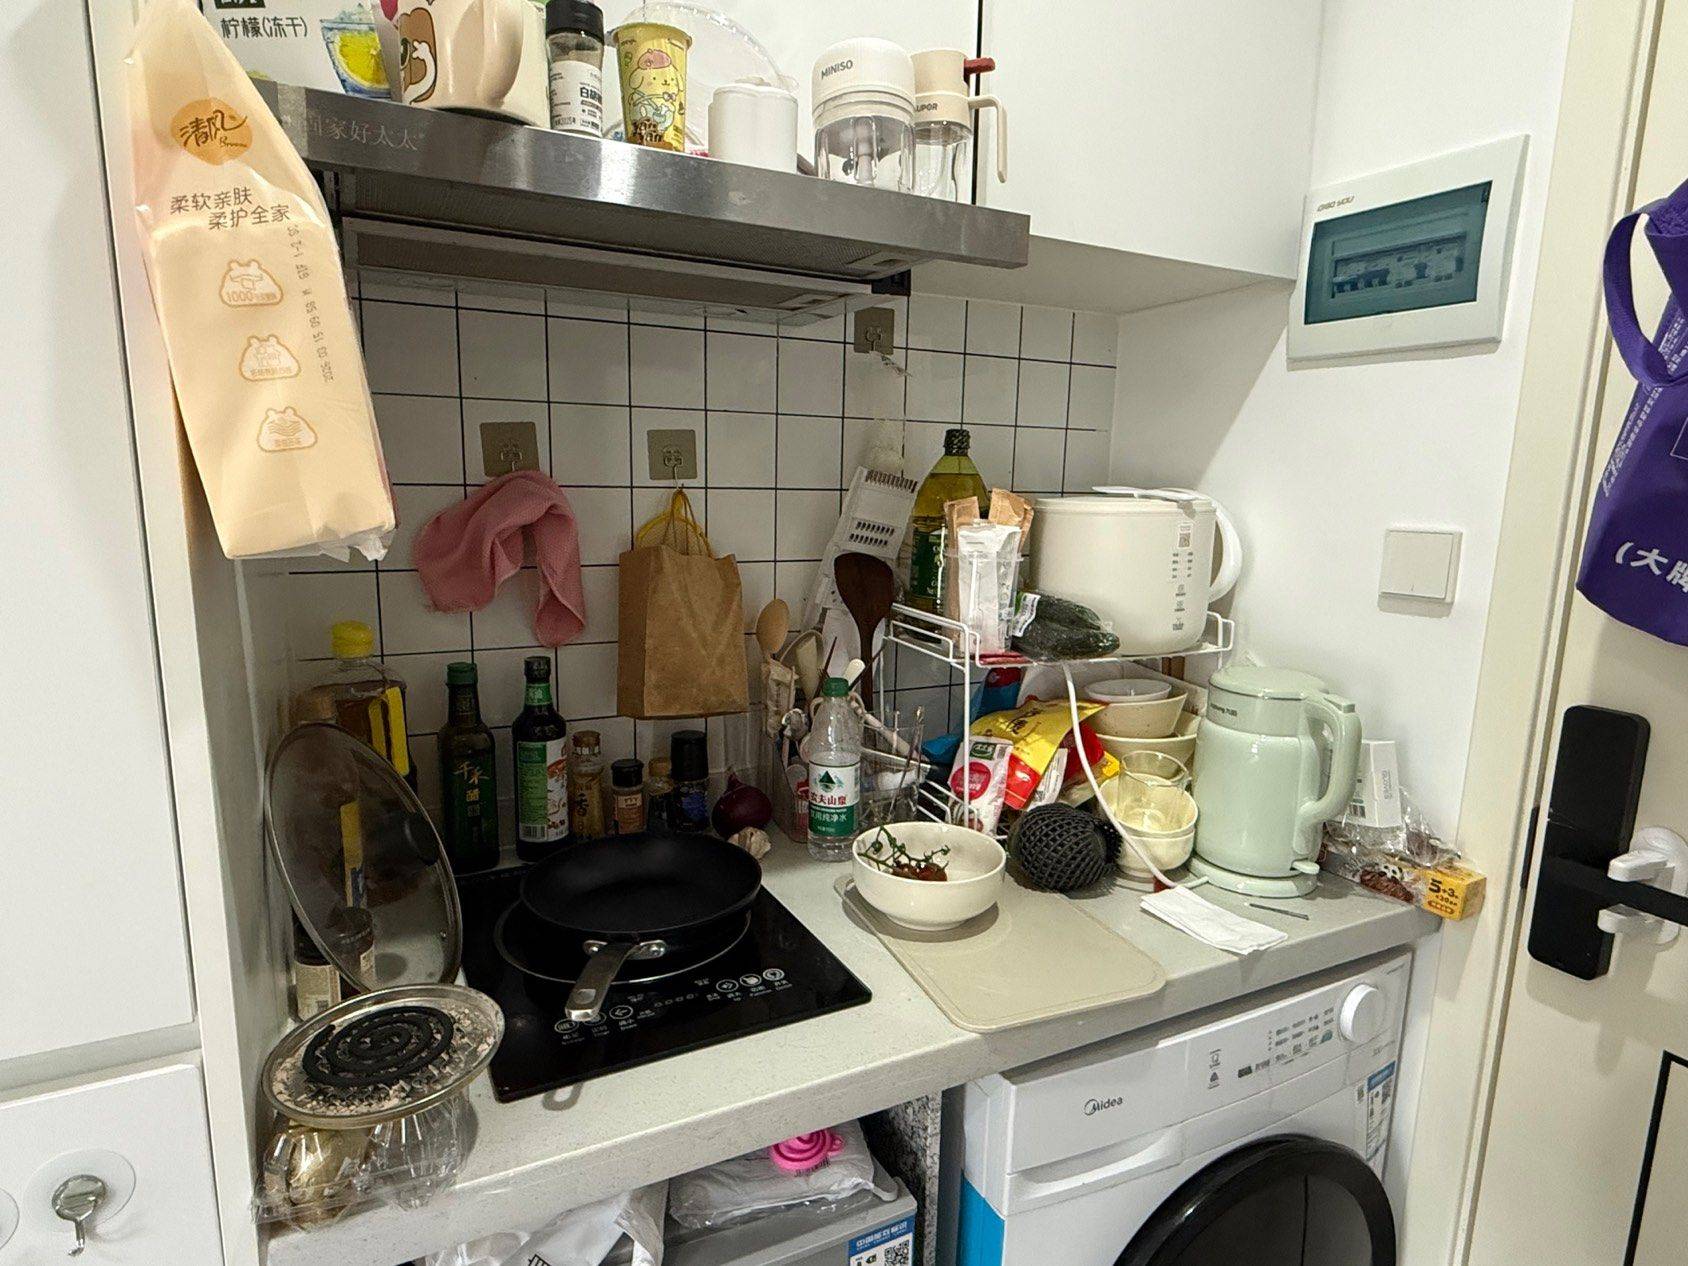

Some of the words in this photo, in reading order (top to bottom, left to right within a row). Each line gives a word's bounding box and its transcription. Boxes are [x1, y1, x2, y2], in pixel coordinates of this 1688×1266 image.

[220, 16, 307, 39] 柠檬(冻干)
[821, 60, 853, 79] MINISO
[916, 103, 938, 112] UPOR
[179, 109, 248, 147] 清风
[170, 187, 252, 215] 柔软亲肤
[208, 204, 290, 230] 柔护全家
[1084, 1096, 1123, 1116] Midea
